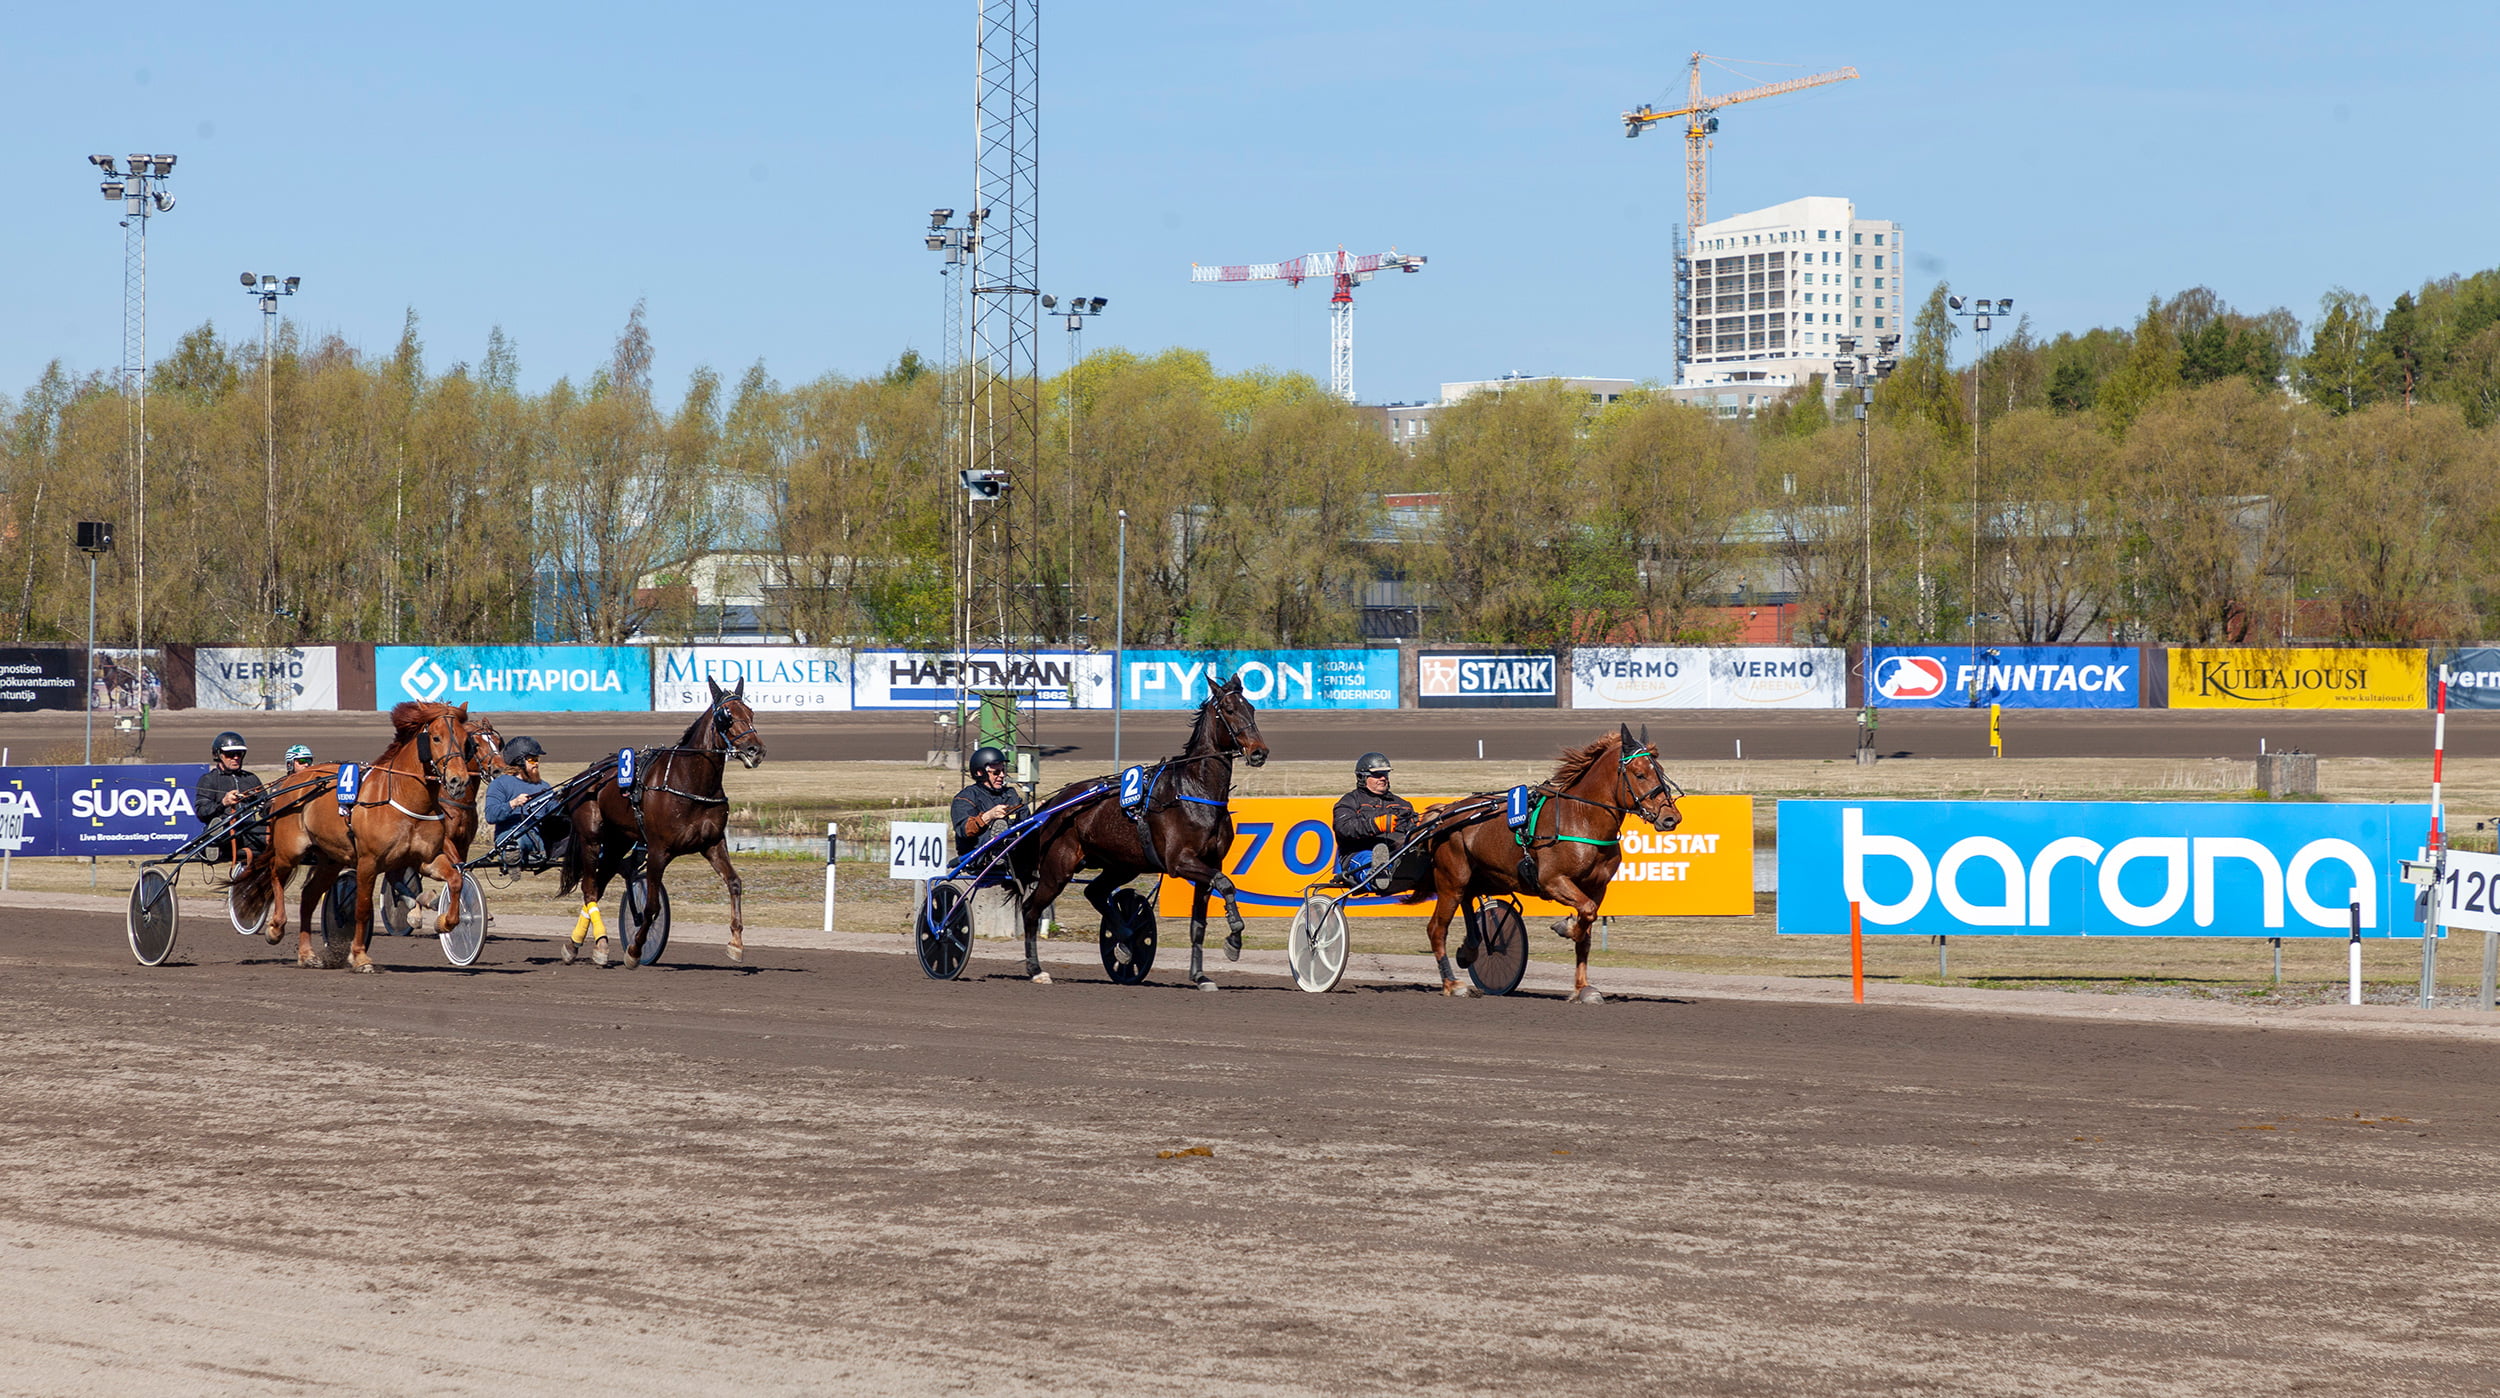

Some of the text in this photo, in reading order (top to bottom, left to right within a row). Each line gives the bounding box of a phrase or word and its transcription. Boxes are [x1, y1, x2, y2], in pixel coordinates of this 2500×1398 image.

[220, 662, 304, 680] VERMO
[453, 664, 621, 692] LÄHITAPIOLA
[664, 651, 844, 683] MEDILASER
[890, 659, 1071, 686] HARTMAN
[1461, 661, 1550, 690] STARK
[1599, 661, 1679, 678] VERMO
[1733, 661, 1814, 678] VERMO
[1956, 664, 2129, 692] FINNTACK
[682, 690, 825, 706] Silkirurgia
[1037, 691, 1067, 700] 1862
[1615, 681, 1667, 691] AREENA
[2334, 694, 2415, 703] www.kultajousi.fi
[621, 749, 632, 777] 3
[340, 765, 354, 792] 4
[1124, 768, 1139, 797] 2
[72, 789, 195, 818] SUORA
[1512, 787, 1520, 815] 1
[97, 833, 149, 841] Broadcasting
[150, 832, 188, 841] Company
[1617, 830, 1720, 854] ÖLISTAT
[894, 835, 942, 869] 2140
[1843, 808, 2376, 928] barona
